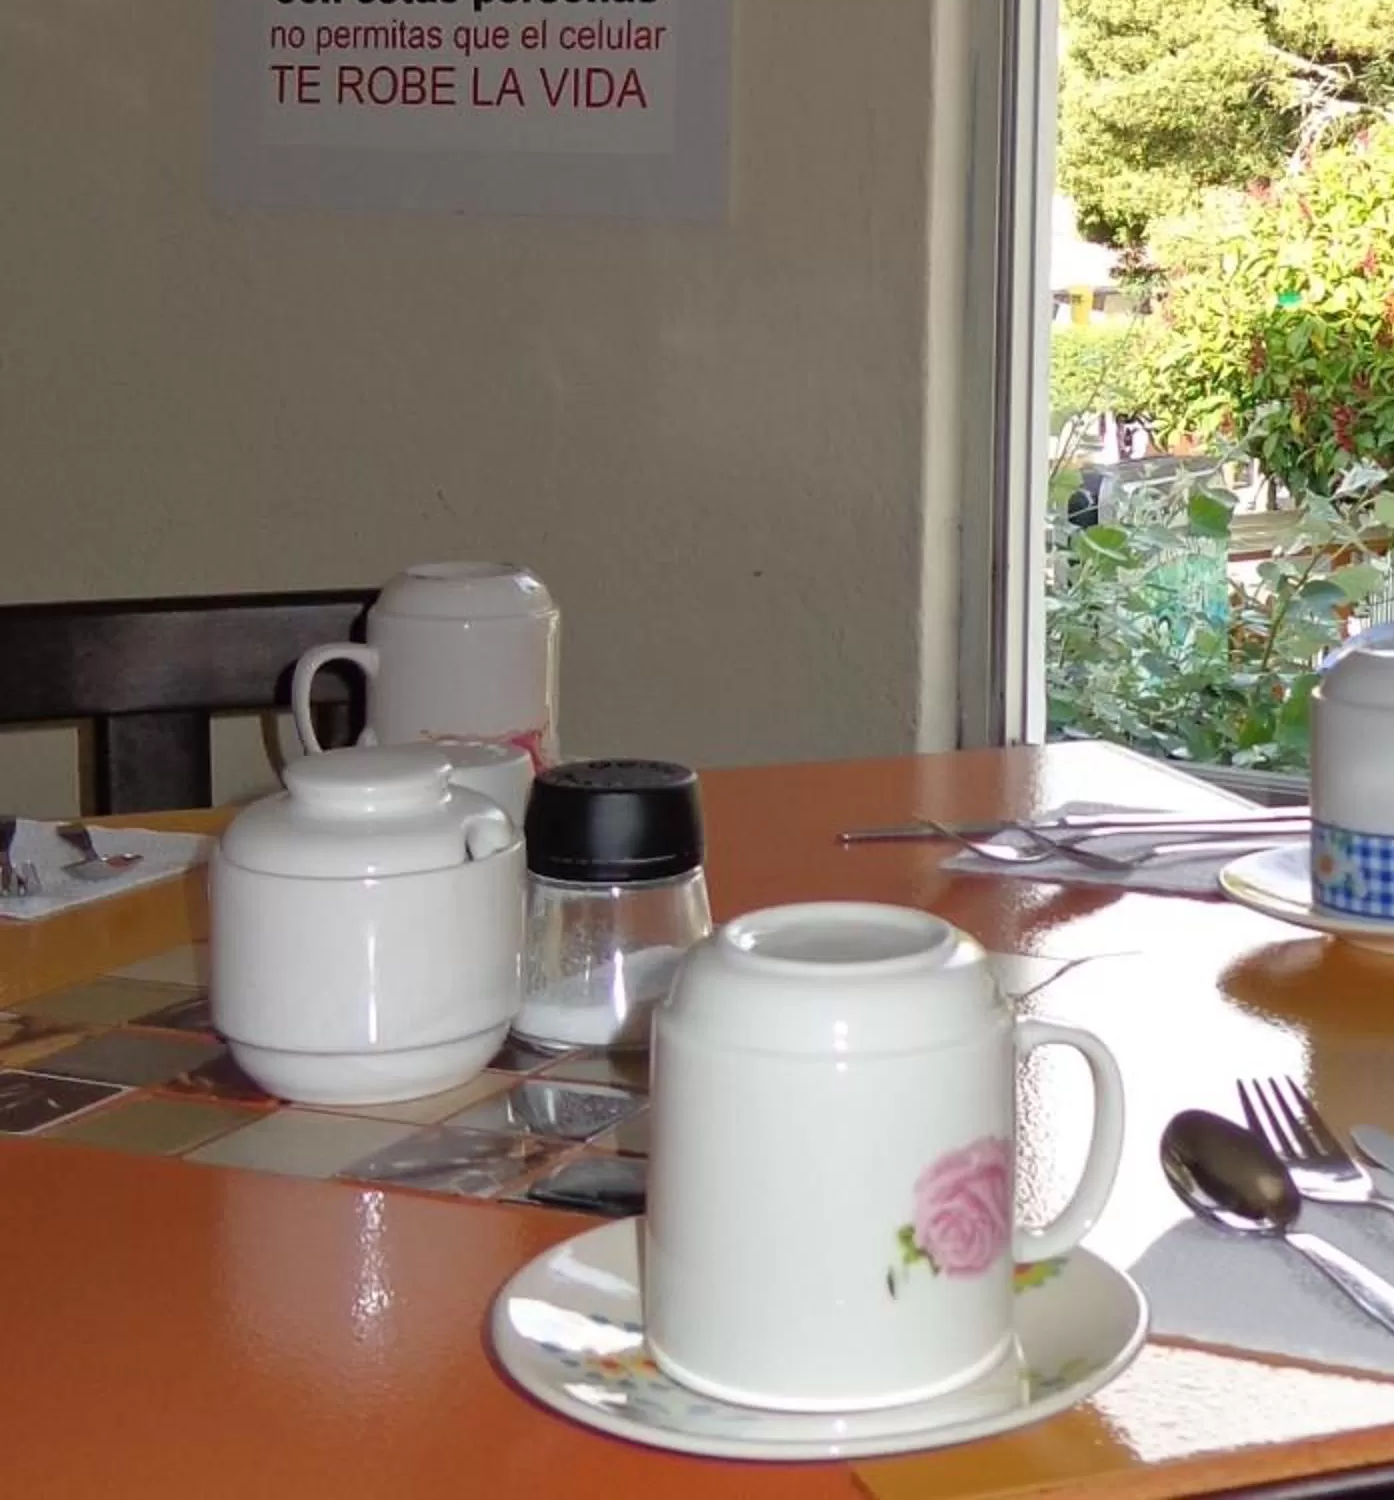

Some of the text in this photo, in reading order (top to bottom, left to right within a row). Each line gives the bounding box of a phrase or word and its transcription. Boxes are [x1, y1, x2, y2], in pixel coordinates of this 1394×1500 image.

[270, 17, 667, 58] no permitas que el celular
[270, 64, 648, 109] TE ROBE LA VIDA
